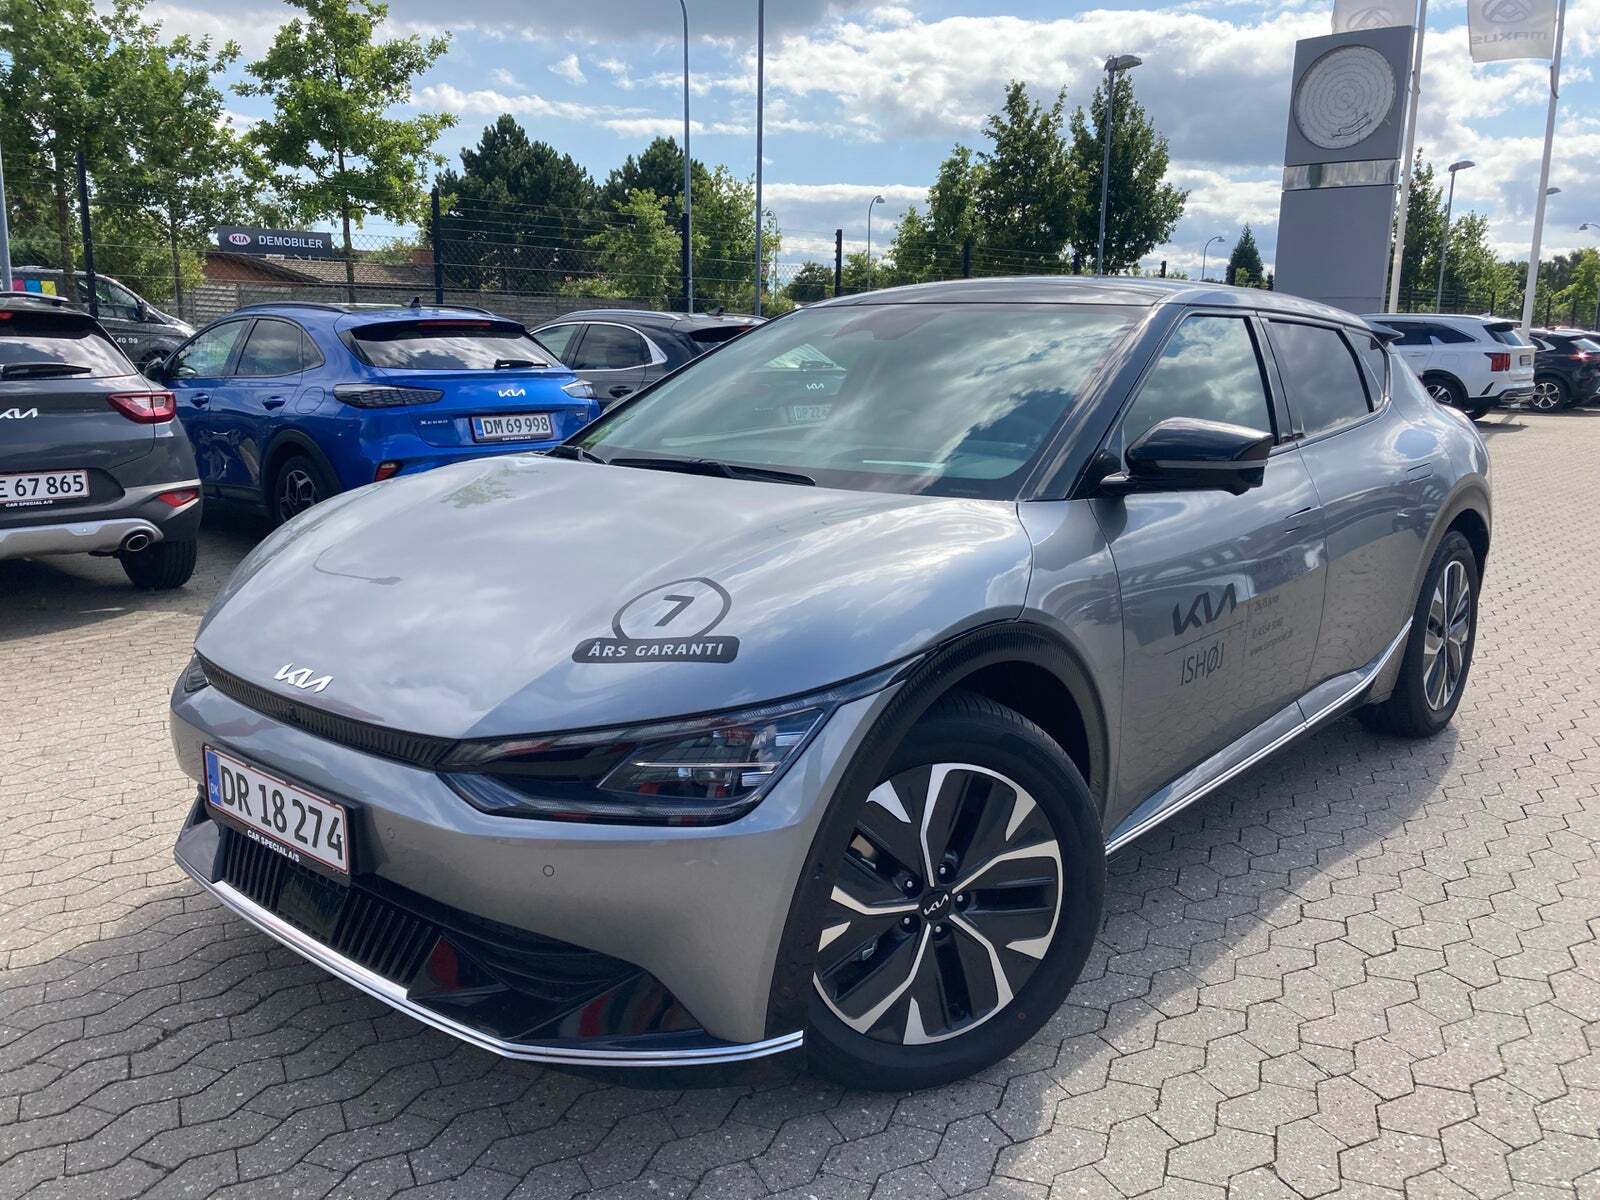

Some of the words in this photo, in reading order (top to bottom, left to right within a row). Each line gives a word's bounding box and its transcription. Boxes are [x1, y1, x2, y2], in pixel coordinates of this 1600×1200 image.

[231, 235, 249, 244] KIA
[258, 235, 323, 249] DEMOBILER
[498, 388, 526, 397] KIA
[483, 420, 504, 434] DM
[506, 418, 522, 433] 69
[524, 416, 549, 432] 998
[14, 478, 40, 497] 67
[46, 475, 84, 494] 865
[654, 594, 696, 627] 7
[1172, 582, 1237, 636] KIA
[587, 641, 629, 657] ÅRS
[635, 643, 724, 657] GARANTI
[1180, 640, 1225, 686] ISHØJ
[274, 663, 334, 693] KIA
[210, 782, 219, 796] DK
[220, 765, 253, 817] DR
[258, 784, 288, 833] 18
[292, 798, 343, 861] 274
[247, 829, 260, 842] CAR
[260, 836, 287, 857] SPECIAL
[287, 850, 300, 863] A/S
[923, 893, 949, 915] KIA
